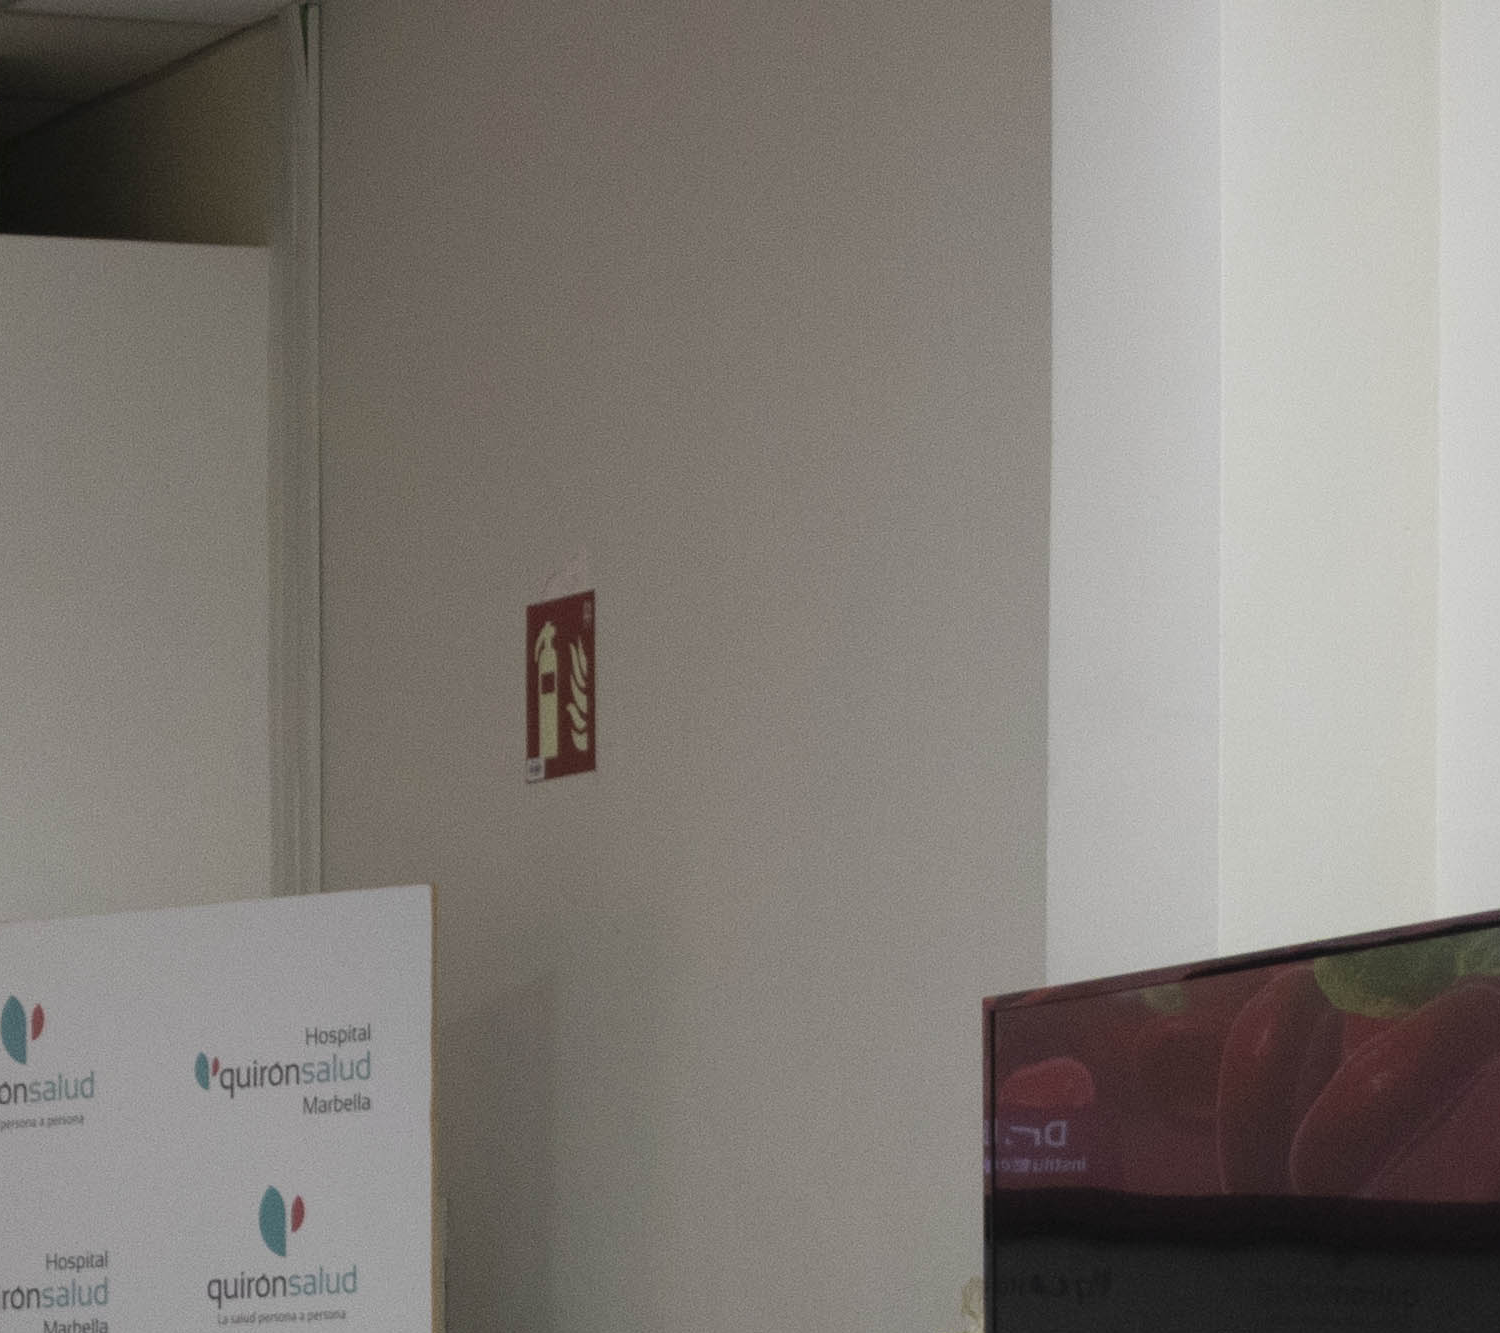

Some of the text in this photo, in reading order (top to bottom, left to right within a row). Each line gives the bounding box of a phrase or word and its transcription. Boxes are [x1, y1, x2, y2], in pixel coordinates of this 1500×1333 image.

[304, 1024, 371, 1047] Hospital
[302, 1093, 371, 1115] Marbella
[44, 1251, 108, 1273] Hospital
